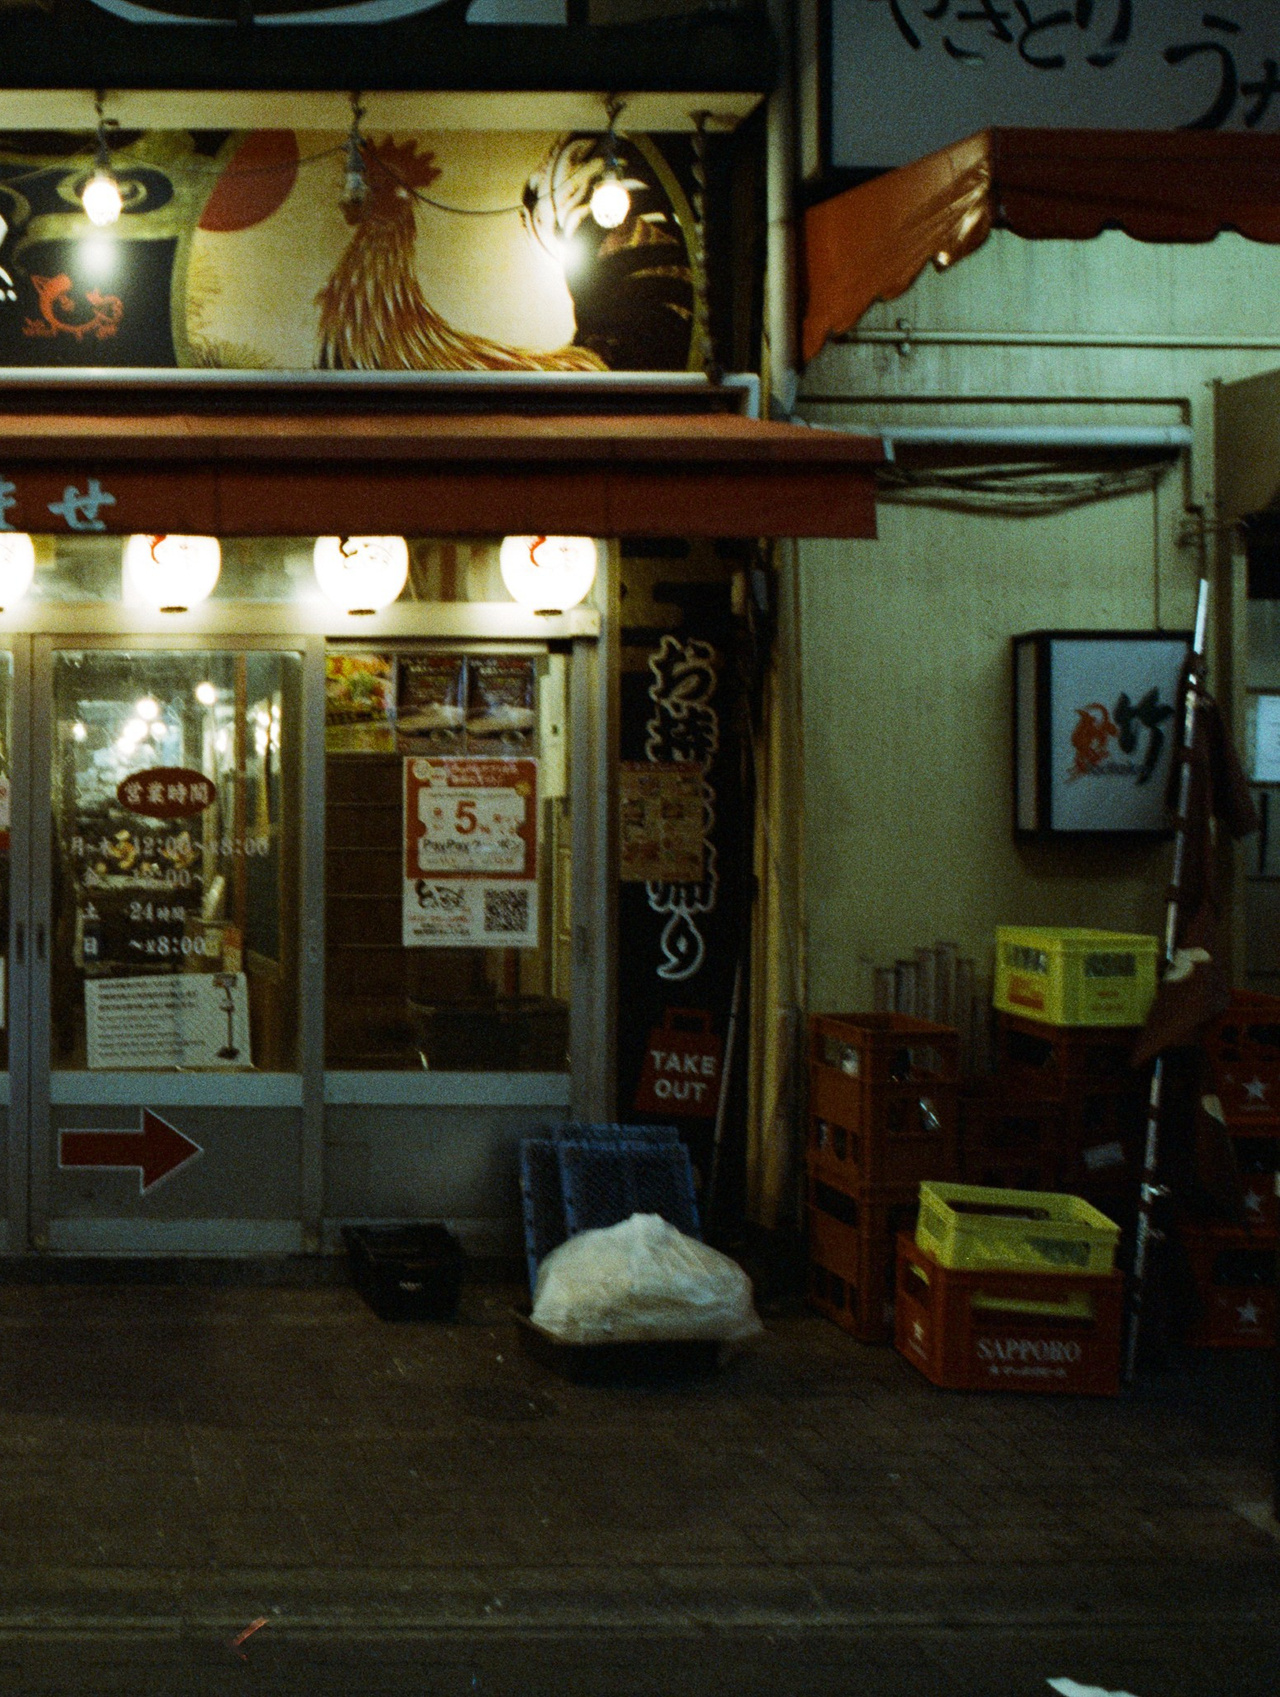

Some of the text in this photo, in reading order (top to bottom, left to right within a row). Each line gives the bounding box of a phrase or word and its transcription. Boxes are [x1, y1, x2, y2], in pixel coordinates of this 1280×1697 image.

[123, 781, 210, 805] 営業時間
[649, 1050, 718, 1076] TAKE
[653, 1078, 708, 1102] OUT
[975, 1336, 1083, 1364] SAPPORO
